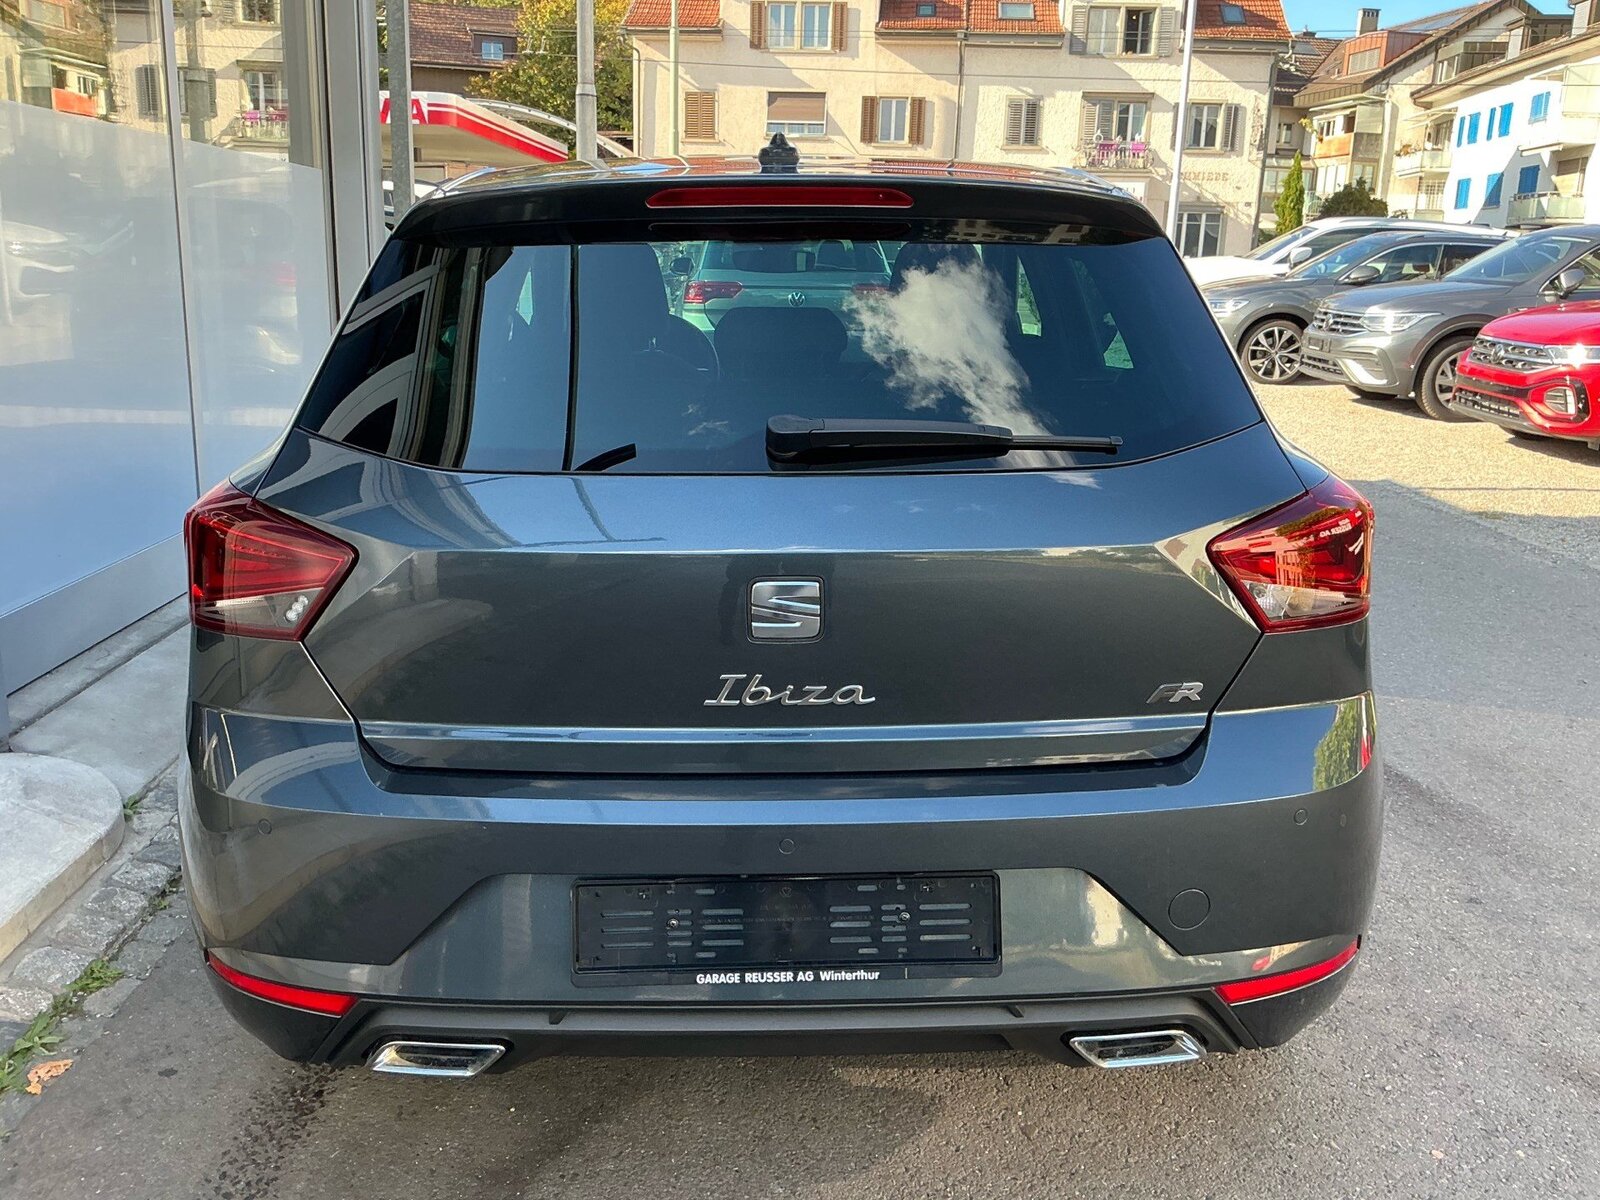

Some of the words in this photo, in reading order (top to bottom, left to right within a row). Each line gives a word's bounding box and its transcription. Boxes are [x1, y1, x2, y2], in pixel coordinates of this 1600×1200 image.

[703, 673, 876, 706] Ibiza
[1145, 681, 1204, 704] FR
[696, 973, 741, 985] GARAGE
[744, 971, 794, 984] REUSSER
[796, 971, 815, 982] AG
[819, 969, 880, 982] Winterthur
